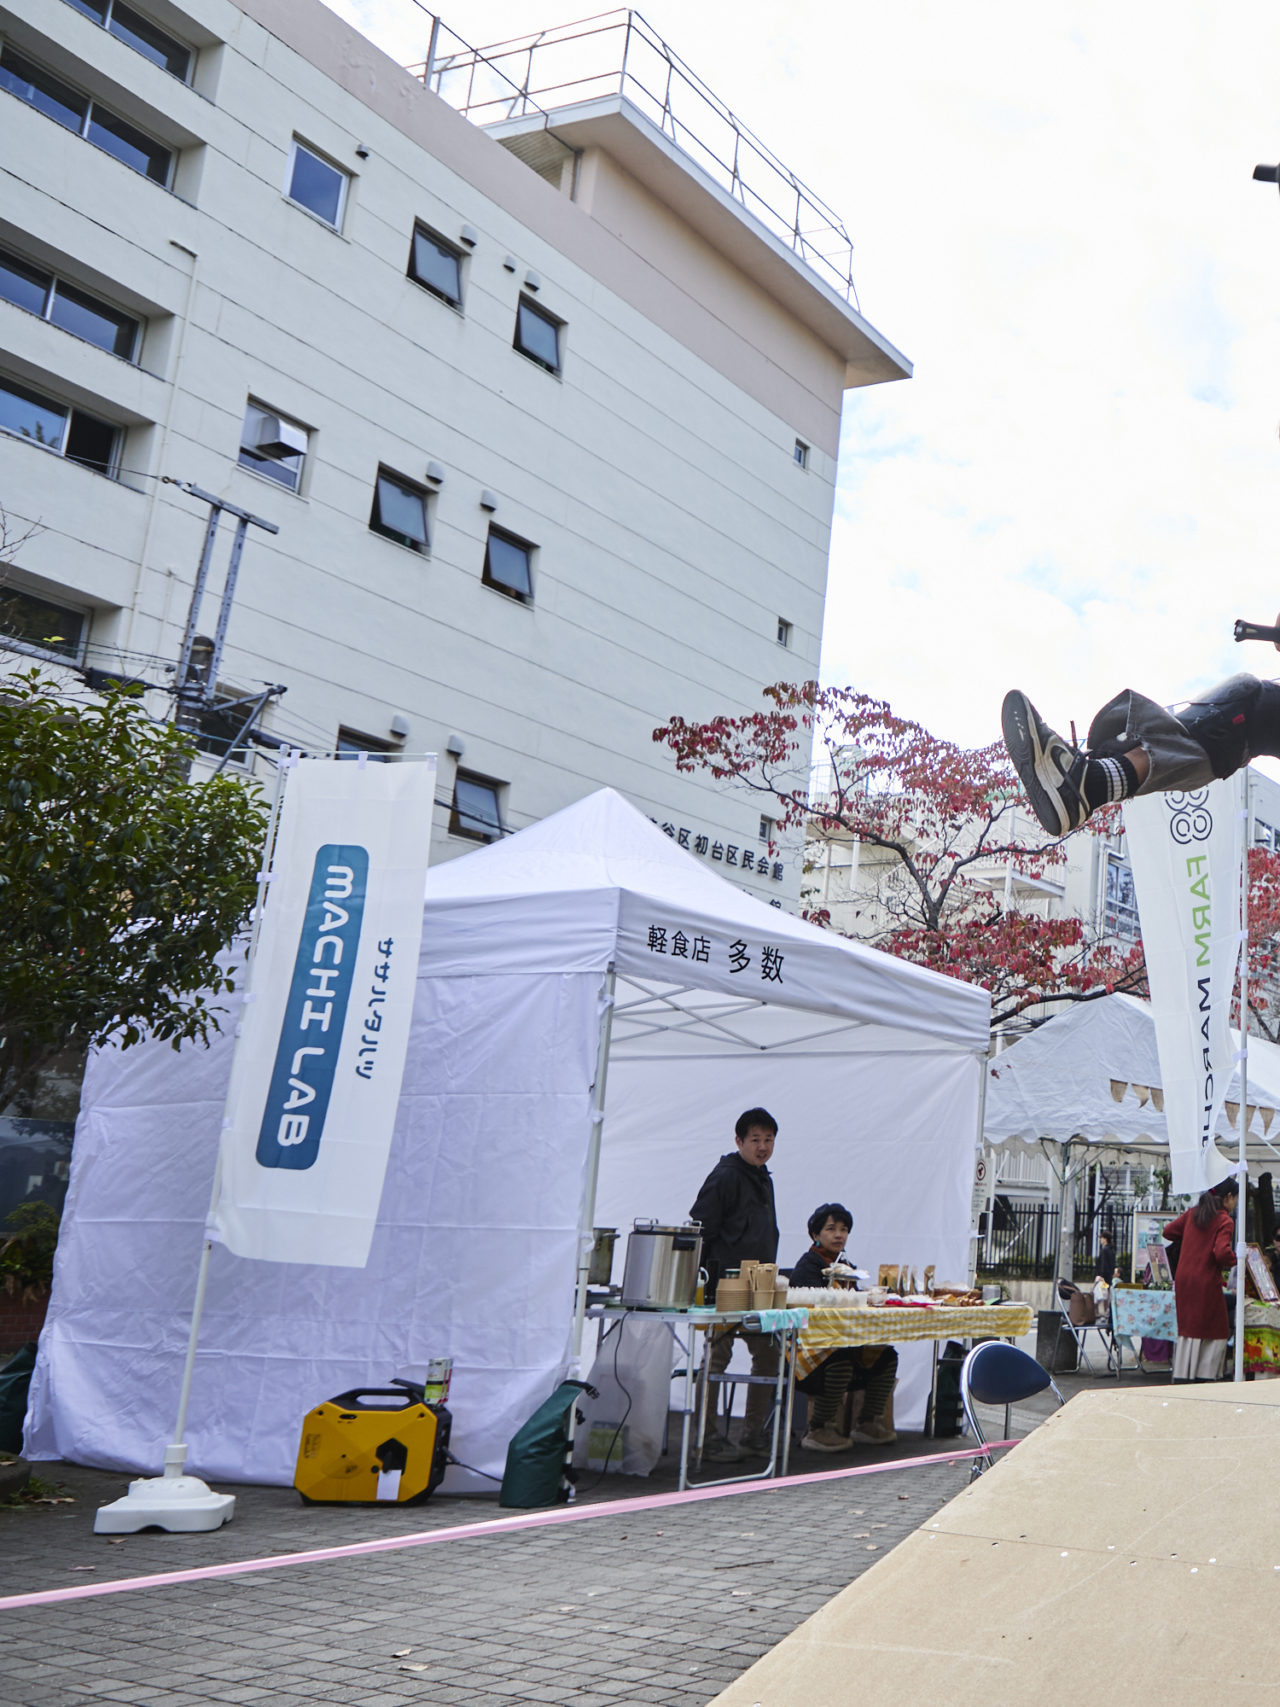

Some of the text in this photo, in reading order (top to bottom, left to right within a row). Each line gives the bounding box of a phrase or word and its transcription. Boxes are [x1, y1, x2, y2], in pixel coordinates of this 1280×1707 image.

[646, 816, 784, 881] 谷区初台区民会館
[277, 865, 354, 1146] MACHI LAB
[647, 925, 785, 984] 軽食店 多数
[355, 937, 394, 1079] ササハタハツ
